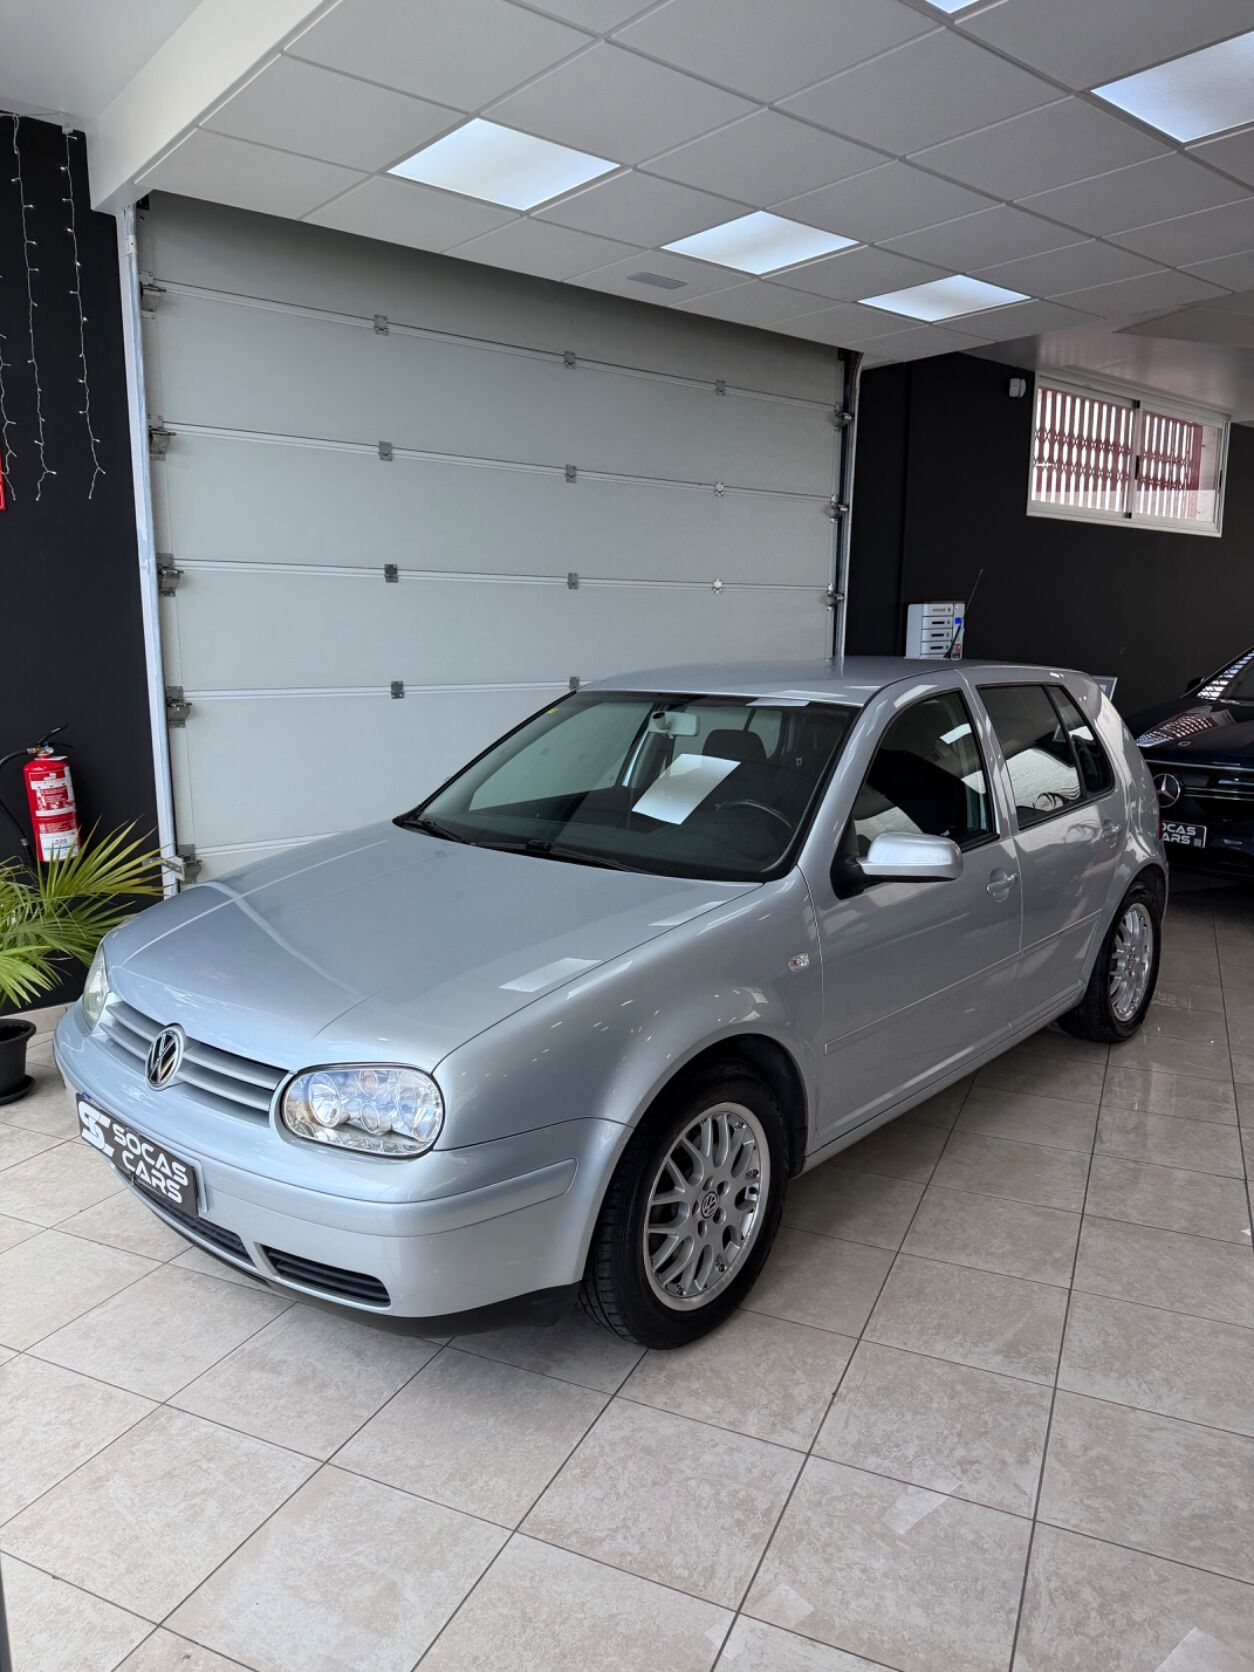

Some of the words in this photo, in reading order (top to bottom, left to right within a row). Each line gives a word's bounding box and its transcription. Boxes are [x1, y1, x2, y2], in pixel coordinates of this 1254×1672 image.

[1162, 822, 1196, 836] CAS
[1163, 832, 1190, 845] ARS
[112, 1123, 188, 1186] SOCAS
[121, 1150, 182, 1203] CARS
